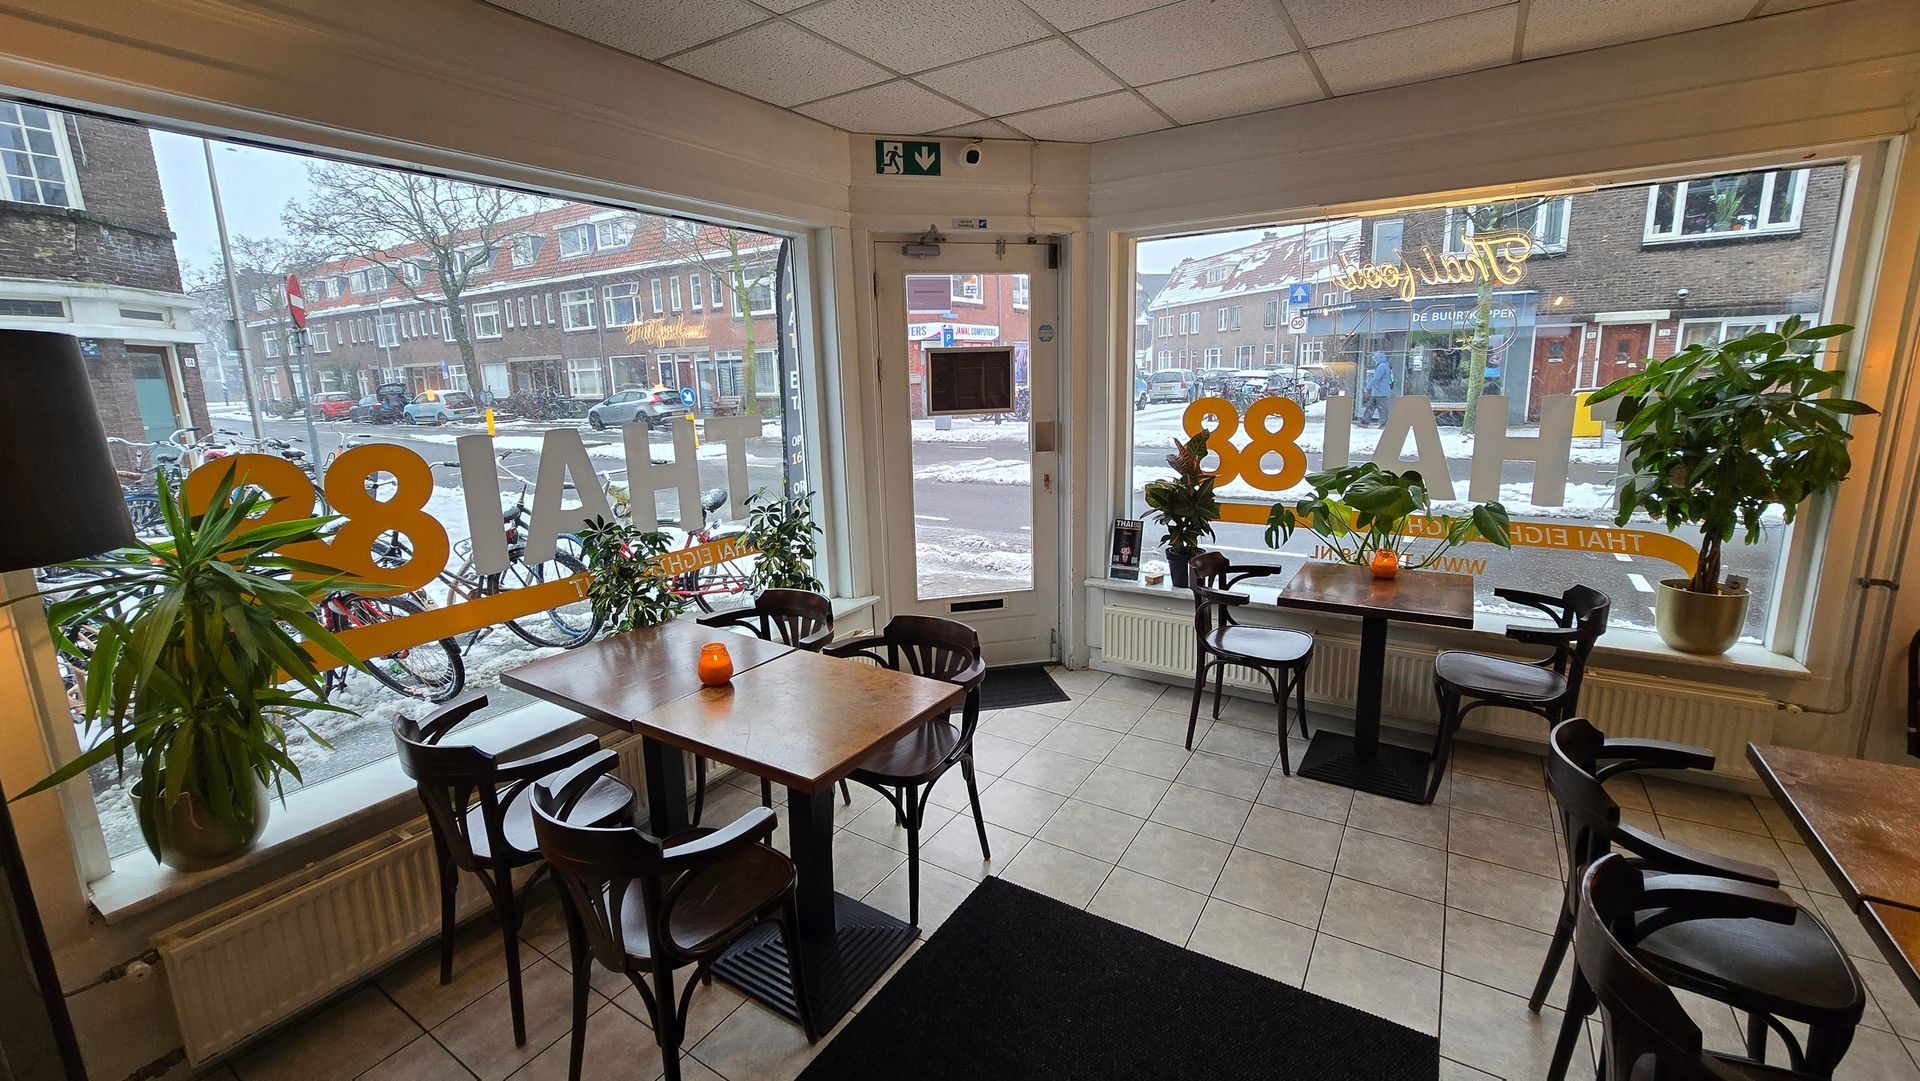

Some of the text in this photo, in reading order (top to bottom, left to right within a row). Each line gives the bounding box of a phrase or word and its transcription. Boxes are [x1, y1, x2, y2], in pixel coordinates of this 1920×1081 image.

[1412, 308, 1516, 322] DE BUURTKPER
[1293, 319, 1303, 327] 30
[955, 326, 970, 336] JAMAL
[971, 327, 996, 337] COMPUTERS
[946, 333, 952, 343] P
